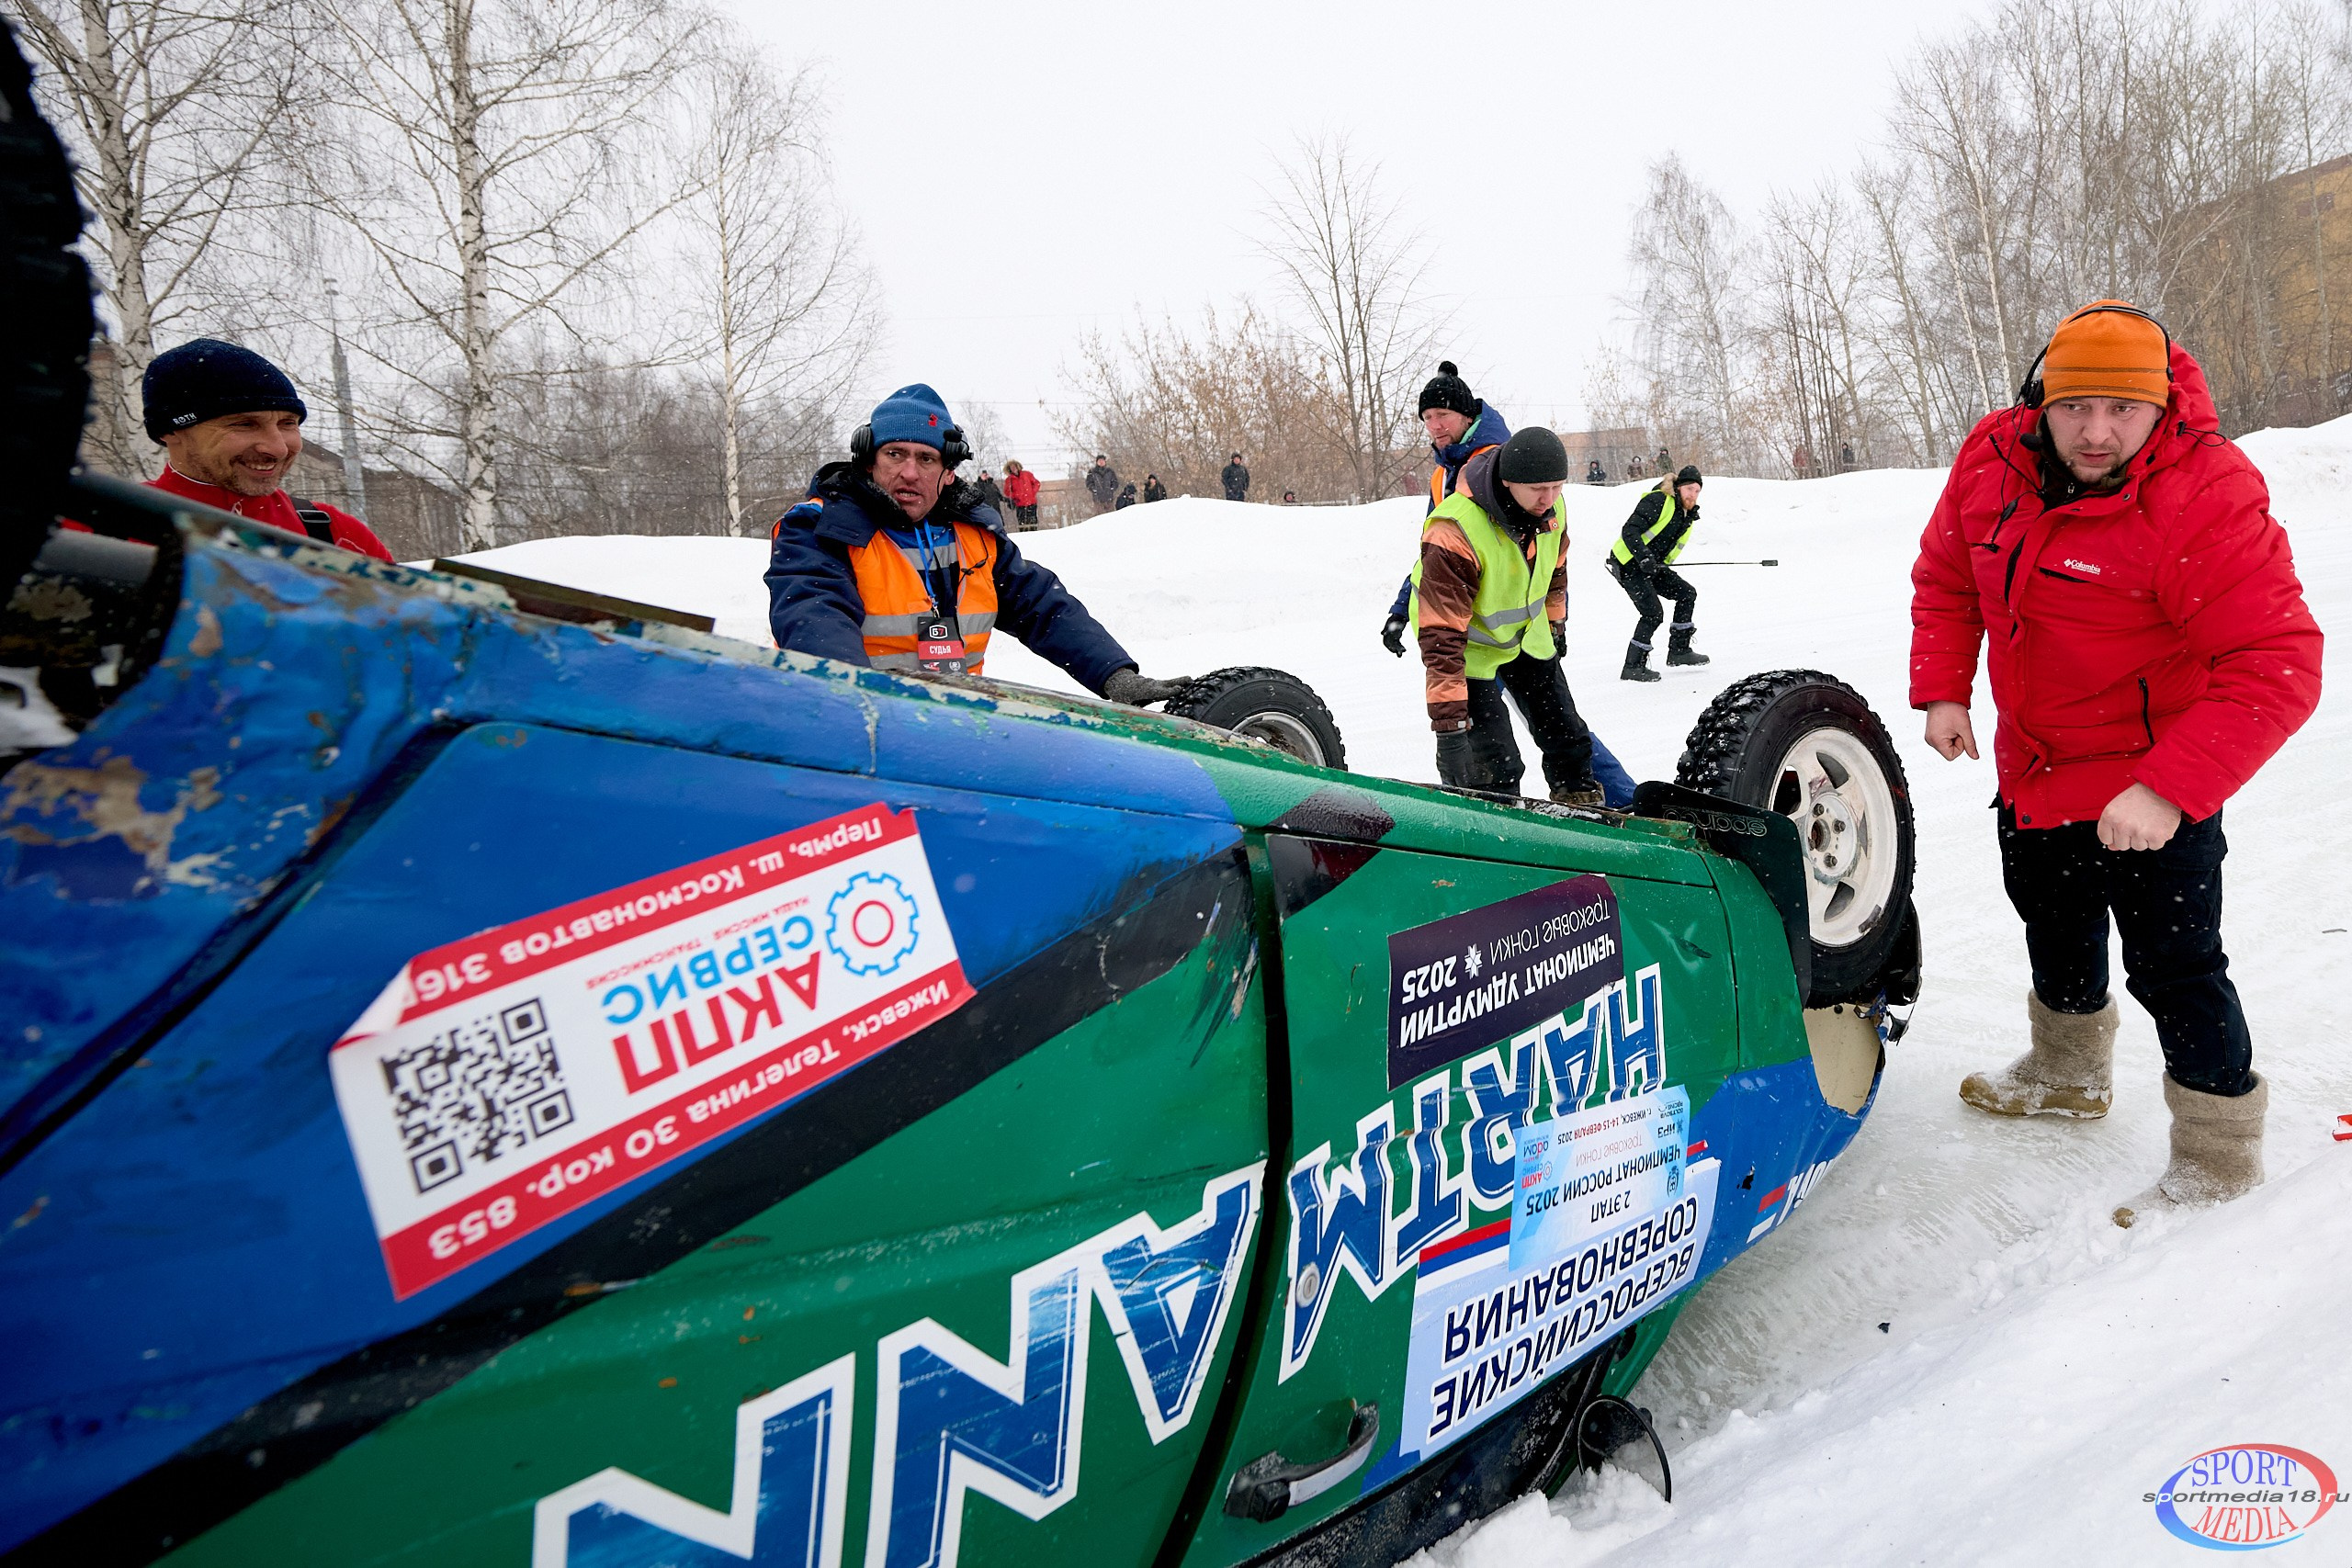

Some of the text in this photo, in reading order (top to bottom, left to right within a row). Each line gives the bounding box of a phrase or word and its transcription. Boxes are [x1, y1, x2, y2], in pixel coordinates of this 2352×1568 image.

[929, 645, 952, 655] СУДЬЯ
[749, 851, 785, 874] ш.
[788, 818, 882, 860] Пермь,
[500, 865, 745, 964] Космонавтов
[602, 915, 815, 1026] СЕРВИС
[1399, 933, 1616, 1048] ЧЕМПИОНАТ УДМУРТИИ
[1401, 955, 1457, 1004] 2025
[612, 951, 821, 1096] АКПП
[427, 979, 950, 1260] Ижевск, Телегина 30 кор. 853
[1557, 1130, 1573, 1145] 2025
[1574, 1121, 1602, 1139] ФЕВРАЛЯ
[1602, 1117, 1620, 1131] 14-15
[1521, 1172, 1543, 1190] АКПП
[1526, 1144, 1680, 1216] ЧЕМПИОНАТ РОССИИ 2025
[1590, 1190, 1631, 1223] 2 ЭТАП
[1443, 1197, 1697, 1363] СОРЕВНОВАНИЯ
[1428, 1241, 1695, 1439] ВСЕРОССИЙСКИЕ
